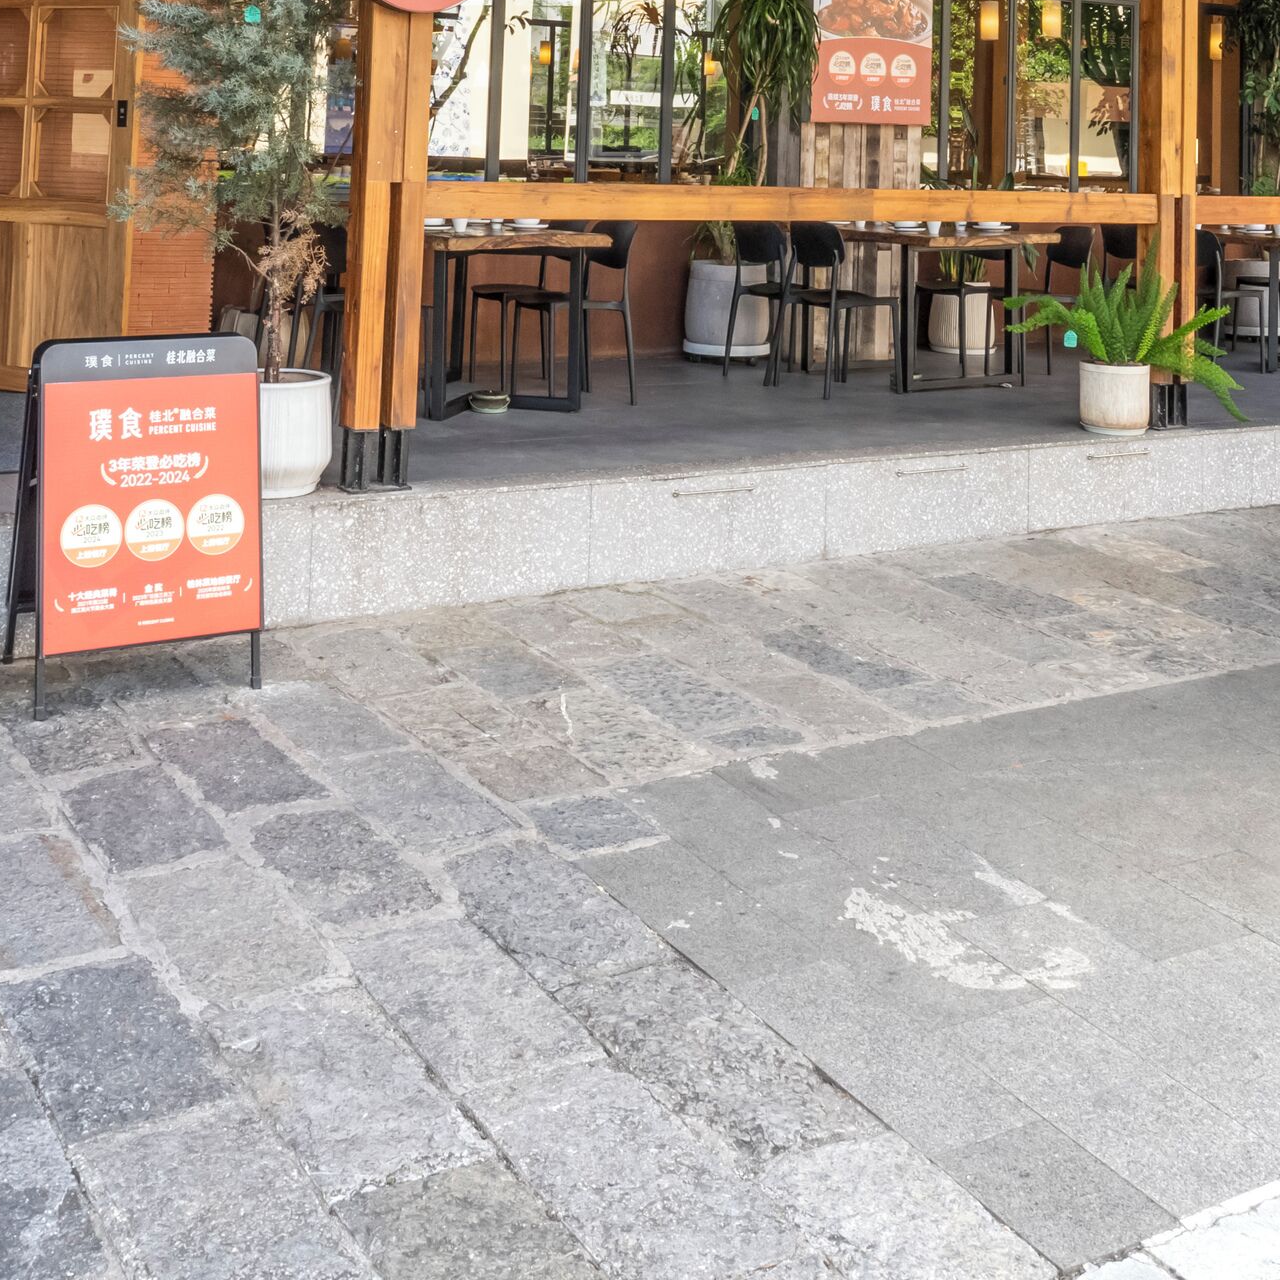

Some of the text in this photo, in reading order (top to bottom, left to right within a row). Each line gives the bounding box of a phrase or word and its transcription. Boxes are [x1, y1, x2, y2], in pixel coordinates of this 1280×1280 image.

[85, 354, 114, 369] 璞食
[125, 352, 154, 360] PERCENT
[166, 348, 217, 365] 桂北融合菜
[89, 406, 143, 442] 璞食
[149, 421, 217, 436] PERCENT CUISINE
[135, 516, 172, 531] 必吃榜
[196, 510, 232, 525] 必吃榜
[71, 521, 110, 537] 必吃榜
